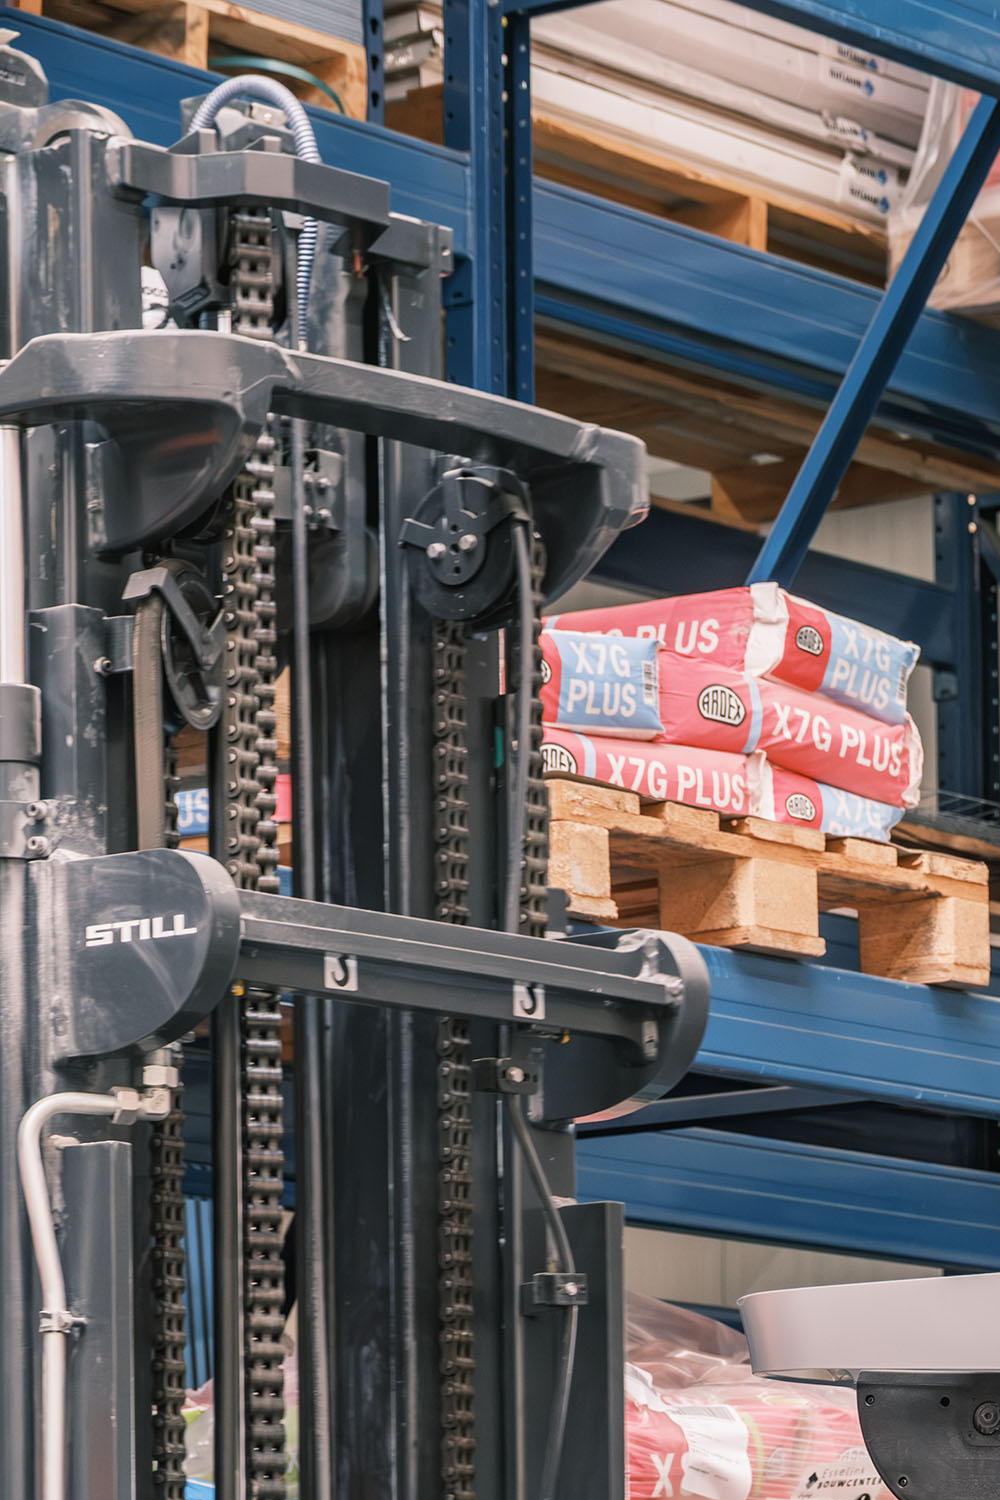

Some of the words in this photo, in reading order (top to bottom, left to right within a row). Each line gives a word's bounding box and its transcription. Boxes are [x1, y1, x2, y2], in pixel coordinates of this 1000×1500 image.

[570, 640, 632, 678] X7G
[841, 624, 892, 673] X7G
[566, 677, 637, 718] PLUS
[830, 657, 891, 710] PLUS
[702, 688, 743, 722] ARDEX
[771, 701, 832, 753] X7G
[839, 723, 904, 778] PLUS
[606, 752, 668, 799] X7G
[676, 764, 746, 811] PLUS
[832, 788, 881, 829] X7G
[85, 914, 198, 947] STILL
